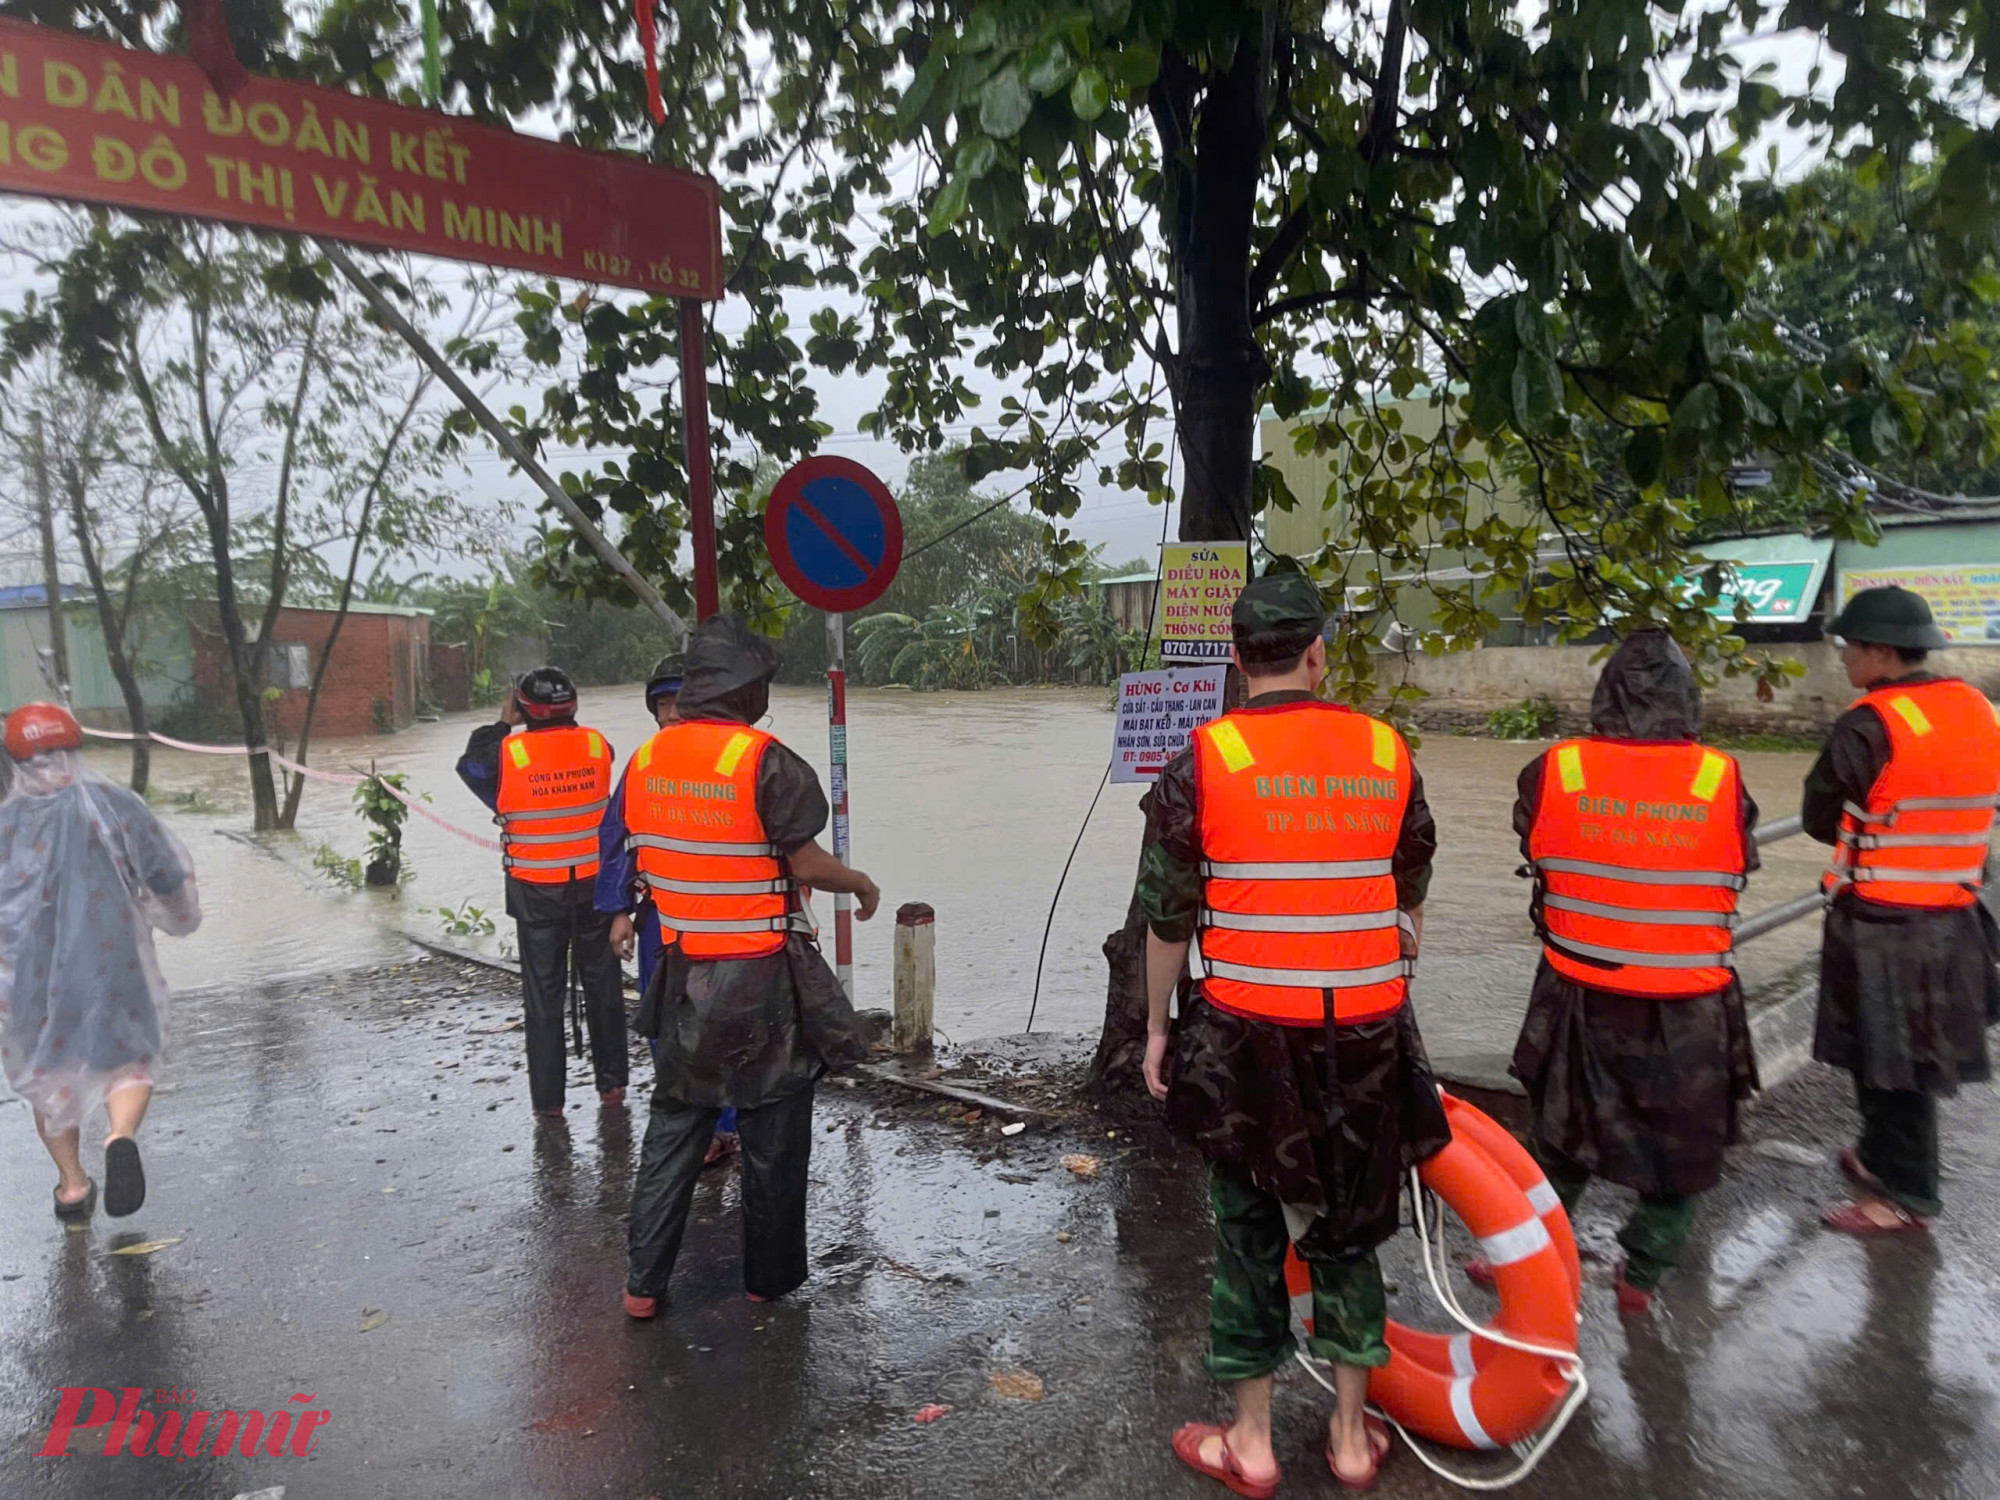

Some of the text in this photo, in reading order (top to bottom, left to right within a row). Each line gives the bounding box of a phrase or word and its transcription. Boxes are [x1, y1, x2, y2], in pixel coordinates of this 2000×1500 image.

[44, 57, 182, 127] DÂN
[203, 91, 371, 165] ĐOÀN
[390, 125, 471, 185] KẾT
[92, 131, 188, 191] ĐÔ
[204, 153, 295, 223] THỊ
[312, 170, 426, 234] VĂN
[444, 199, 563, 259] MINH
[1190, 548, 1219, 562] SỬA
[1209, 565, 1242, 580] HÒA
[1166, 584, 1200, 598] MÁY
[1166, 602, 1233, 619] ĐIỆN NƯỚ
[1164, 619, 1233, 635] THÔNG CỐN
[1125, 681, 1162, 696] HÙNG
[1173, 682, 1190, 693] Cơ
[1189, 699, 1202, 711] LAN
[1203, 698, 1217, 711] CAN
[1139, 751, 1163, 762] 0905
[528, 773, 551, 783] CÔNG
[554, 772, 564, 780] AN
[580, 780, 595, 790] NAM
[1255, 770, 1398, 800] BIÊN PHÒNG
[1578, 795, 1709, 823] BIÊN PHÒNG
